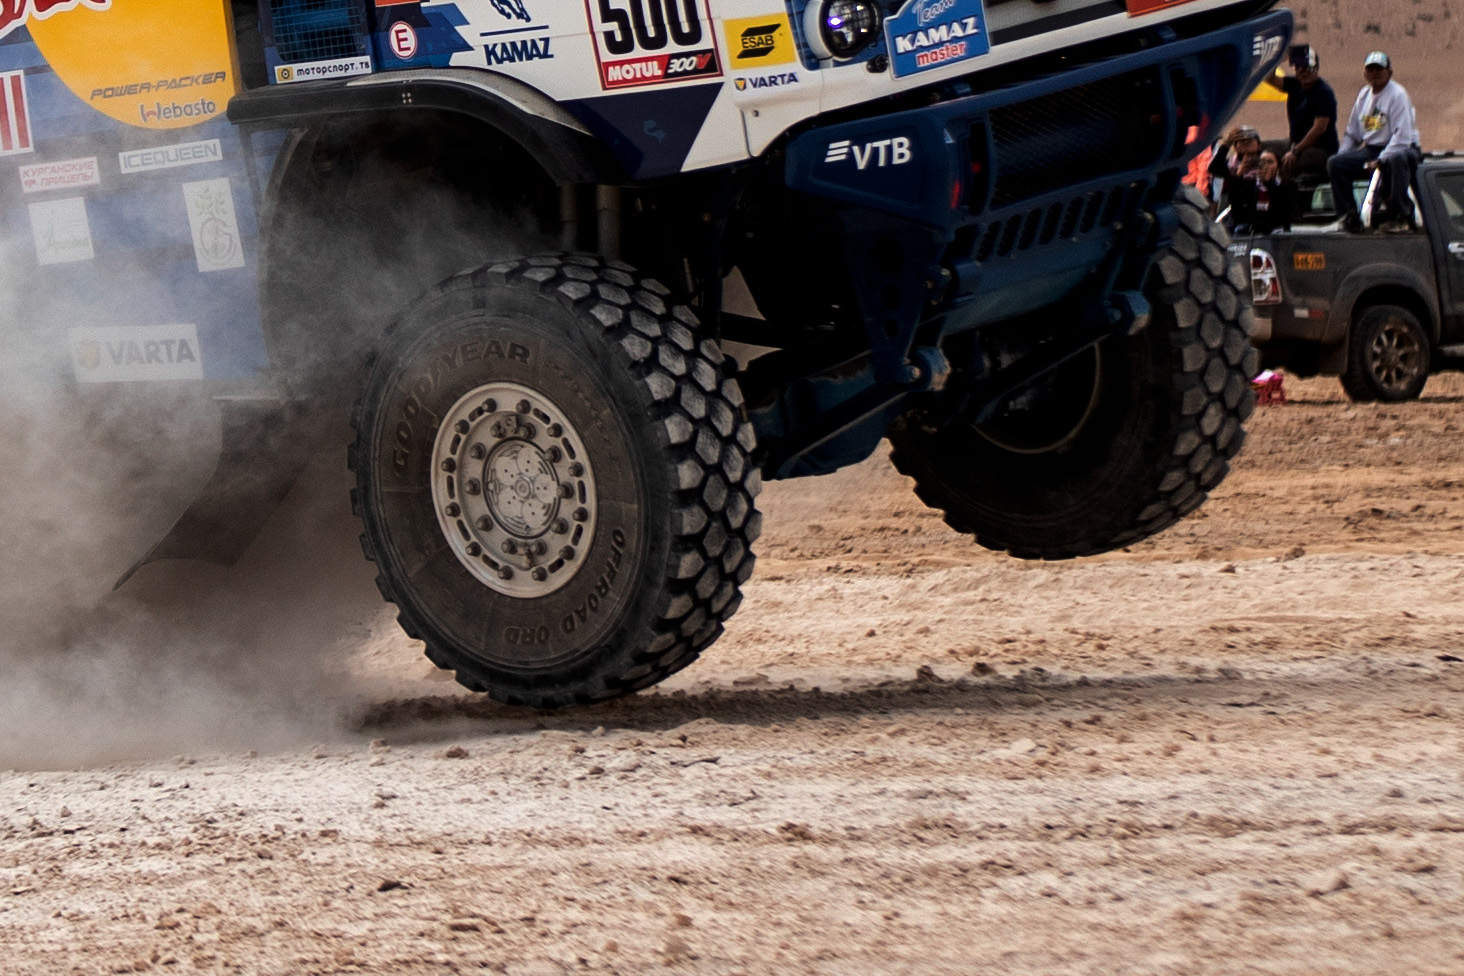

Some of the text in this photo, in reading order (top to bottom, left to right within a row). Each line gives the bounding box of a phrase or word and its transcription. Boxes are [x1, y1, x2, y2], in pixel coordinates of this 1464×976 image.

[394, 28, 411, 52] E
[741, 34, 775, 49] ESAB
[895, 17, 979, 54] KAMAZ
[483, 37, 554, 66] KAMAZ
[916, 41, 967, 67] master
[607, 53, 713, 82] MOTUL 300V
[749, 72, 799, 89] VARTA
[90, 71, 226, 100] POWER-PACKER
[139, 97, 217, 123] Webasto
[123, 142, 218, 170] ICEQUEEN
[852, 136, 912, 171] VTB
[103, 337, 198, 367] VARTA
